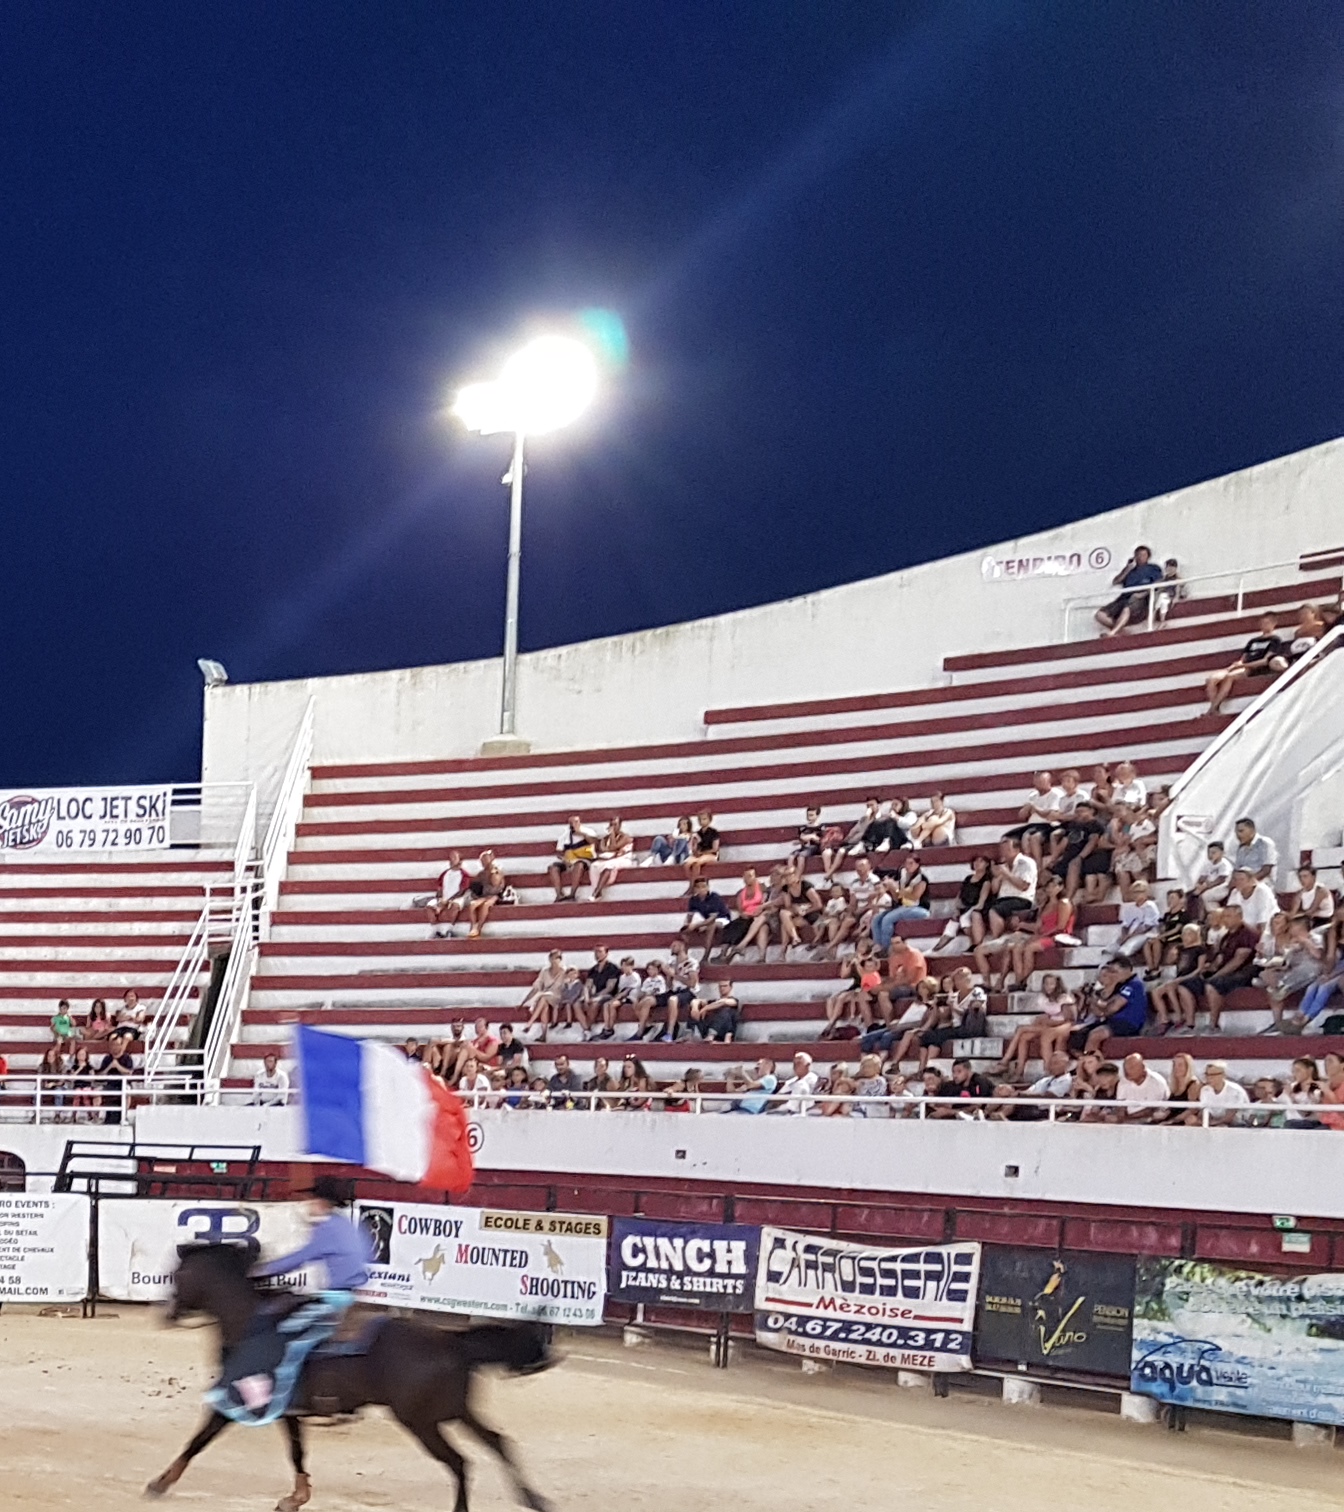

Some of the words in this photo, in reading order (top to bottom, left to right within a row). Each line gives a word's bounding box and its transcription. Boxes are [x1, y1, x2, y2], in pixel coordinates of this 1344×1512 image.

[56, 797, 93, 821] LOC
[99, 796, 132, 821] JET
[56, 829, 73, 848] 06
[79, 829, 97, 848] 79
[101, 828, 119, 848] 72
[124, 827, 142, 846] 90
[147, 825, 166, 845] 70
[14, 1200, 50, 1208] EVENTS
[397, 1214, 463, 1238] COWBOY
[483, 1215, 531, 1231] ECOLE
[534, 1217, 544, 1231] &
[548, 1219, 602, 1236] STAGES
[455, 1243, 529, 1269] MOUNTED
[620, 1234, 747, 1275] CINCH
[619, 1270, 668, 1288] JEANS
[670, 1275, 681, 1289] &
[683, 1276, 744, 1294] SHIRTS
[766, 1237, 976, 1302] CARROSSERIE
[519, 1274, 597, 1300] SHOOTING
[767, 1314, 963, 1350] 04.67.240.312
[786, 1338, 806, 1353] Mas
[808, 1342, 822, 1355] de
[823, 1344, 857, 1360] Garric
[882, 1350, 897, 1364] de
[900, 1354, 936, 1368] MEZE
[1139, 1360, 1214, 1394] aqua
